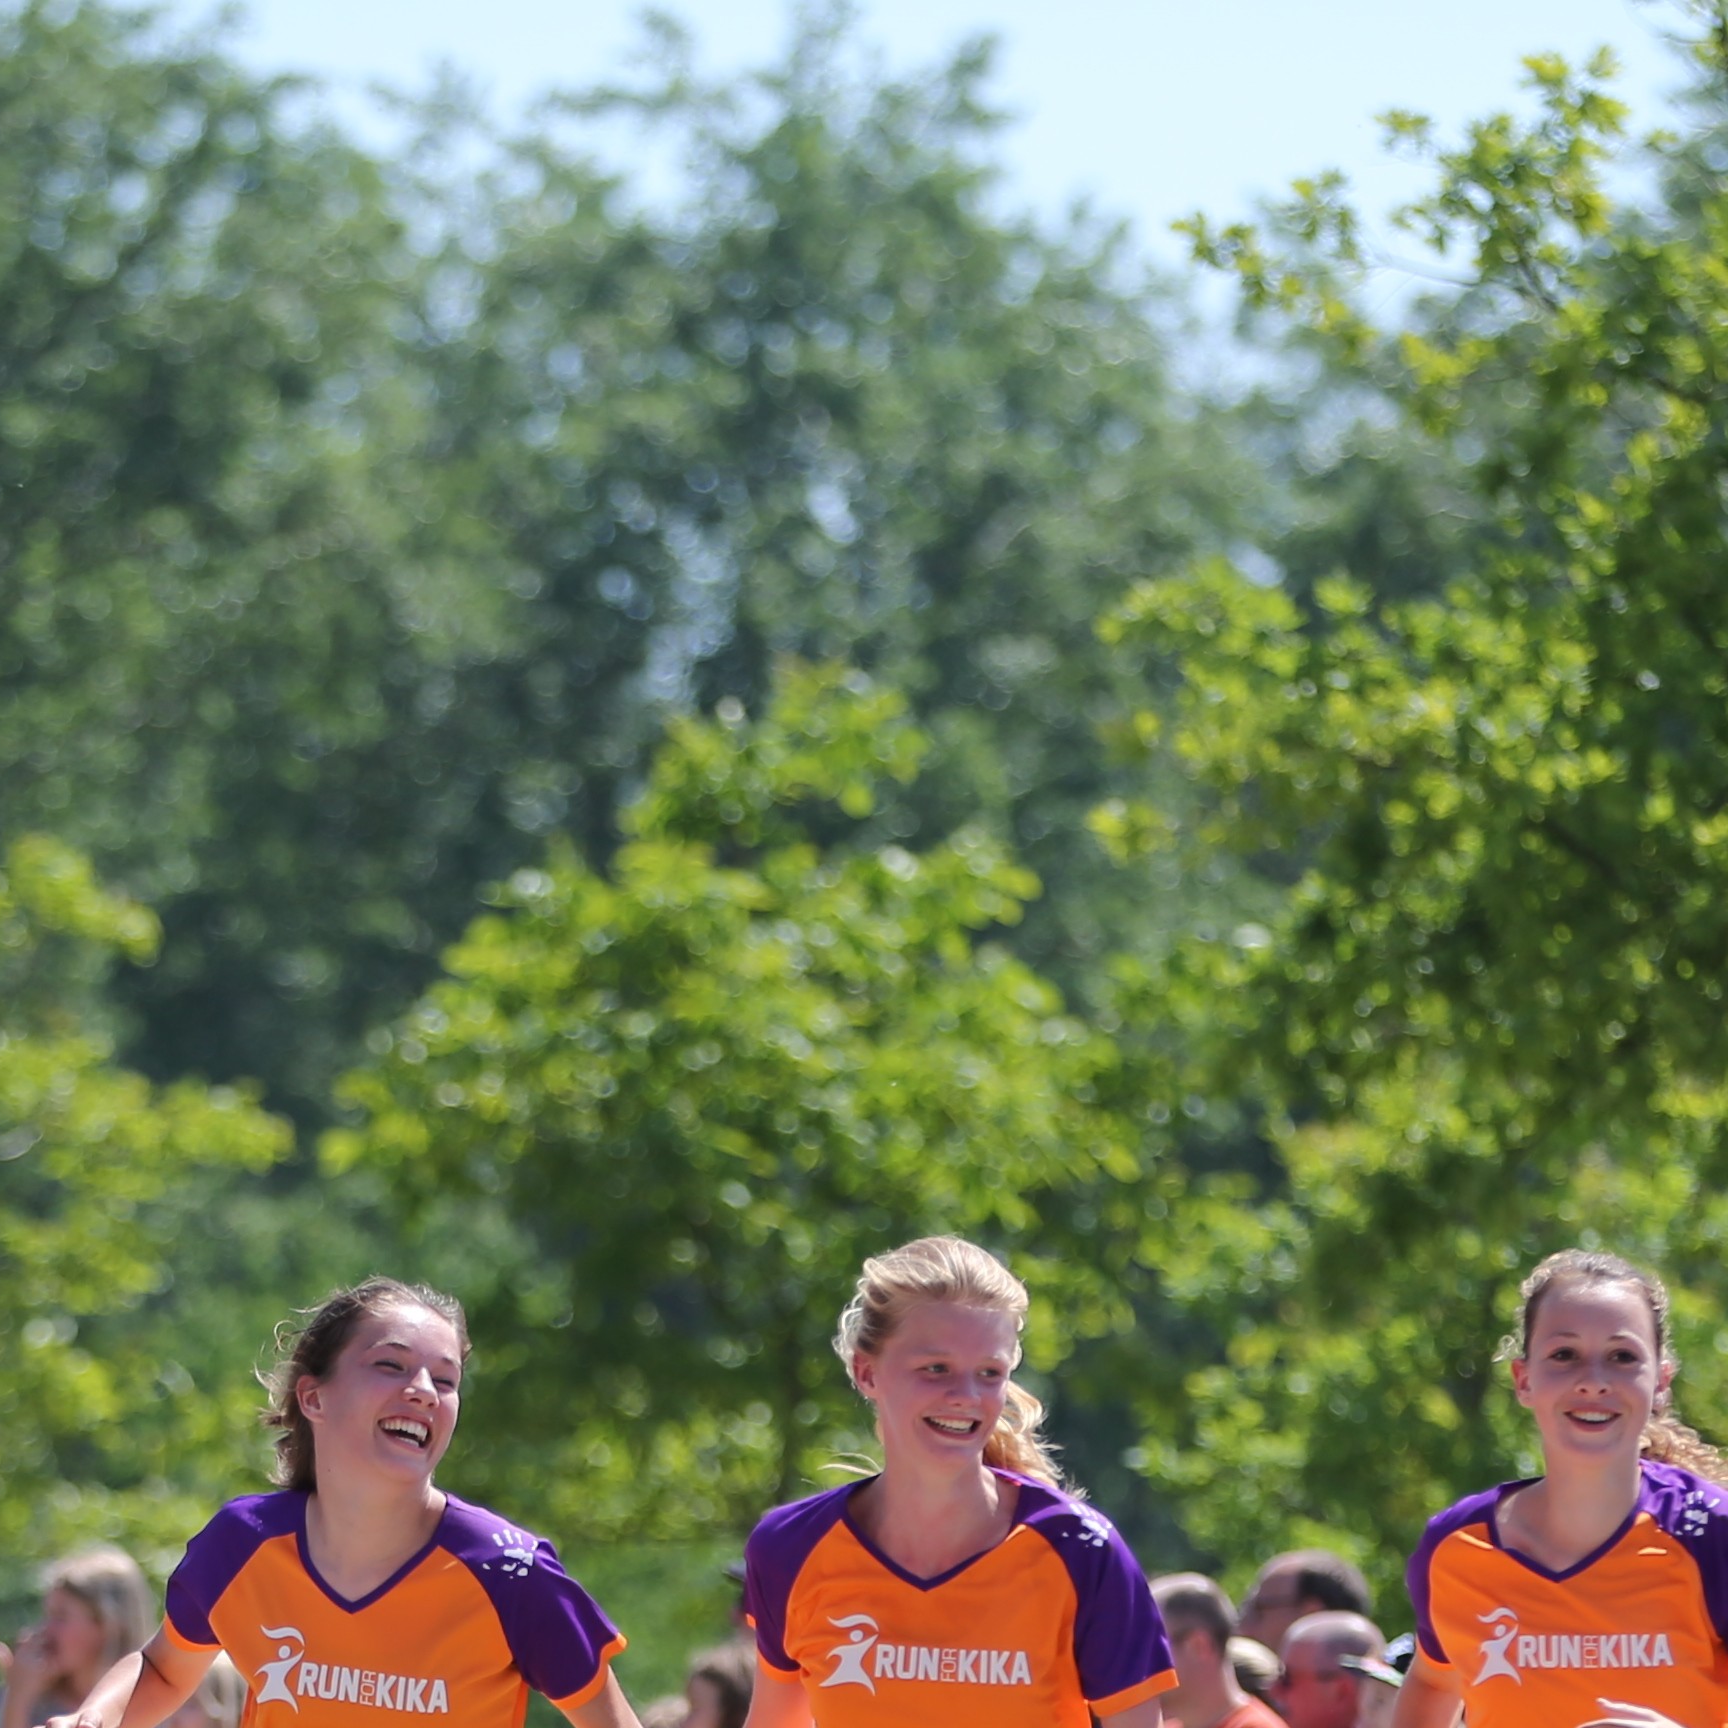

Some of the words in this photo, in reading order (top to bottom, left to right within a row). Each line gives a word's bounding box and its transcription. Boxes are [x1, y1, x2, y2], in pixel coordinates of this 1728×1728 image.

[874, 1644, 941, 1681] RUN
[940, 1648, 957, 1683] FOR
[957, 1649, 1032, 1685] KIKA
[1517, 1634, 1582, 1668] RUN
[1583, 1635, 1599, 1669] FOR
[1599, 1633, 1674, 1668] KIKA
[297, 1661, 361, 1703] RUN
[359, 1670, 377, 1706] FOR
[375, 1673, 448, 1714] KIKA
